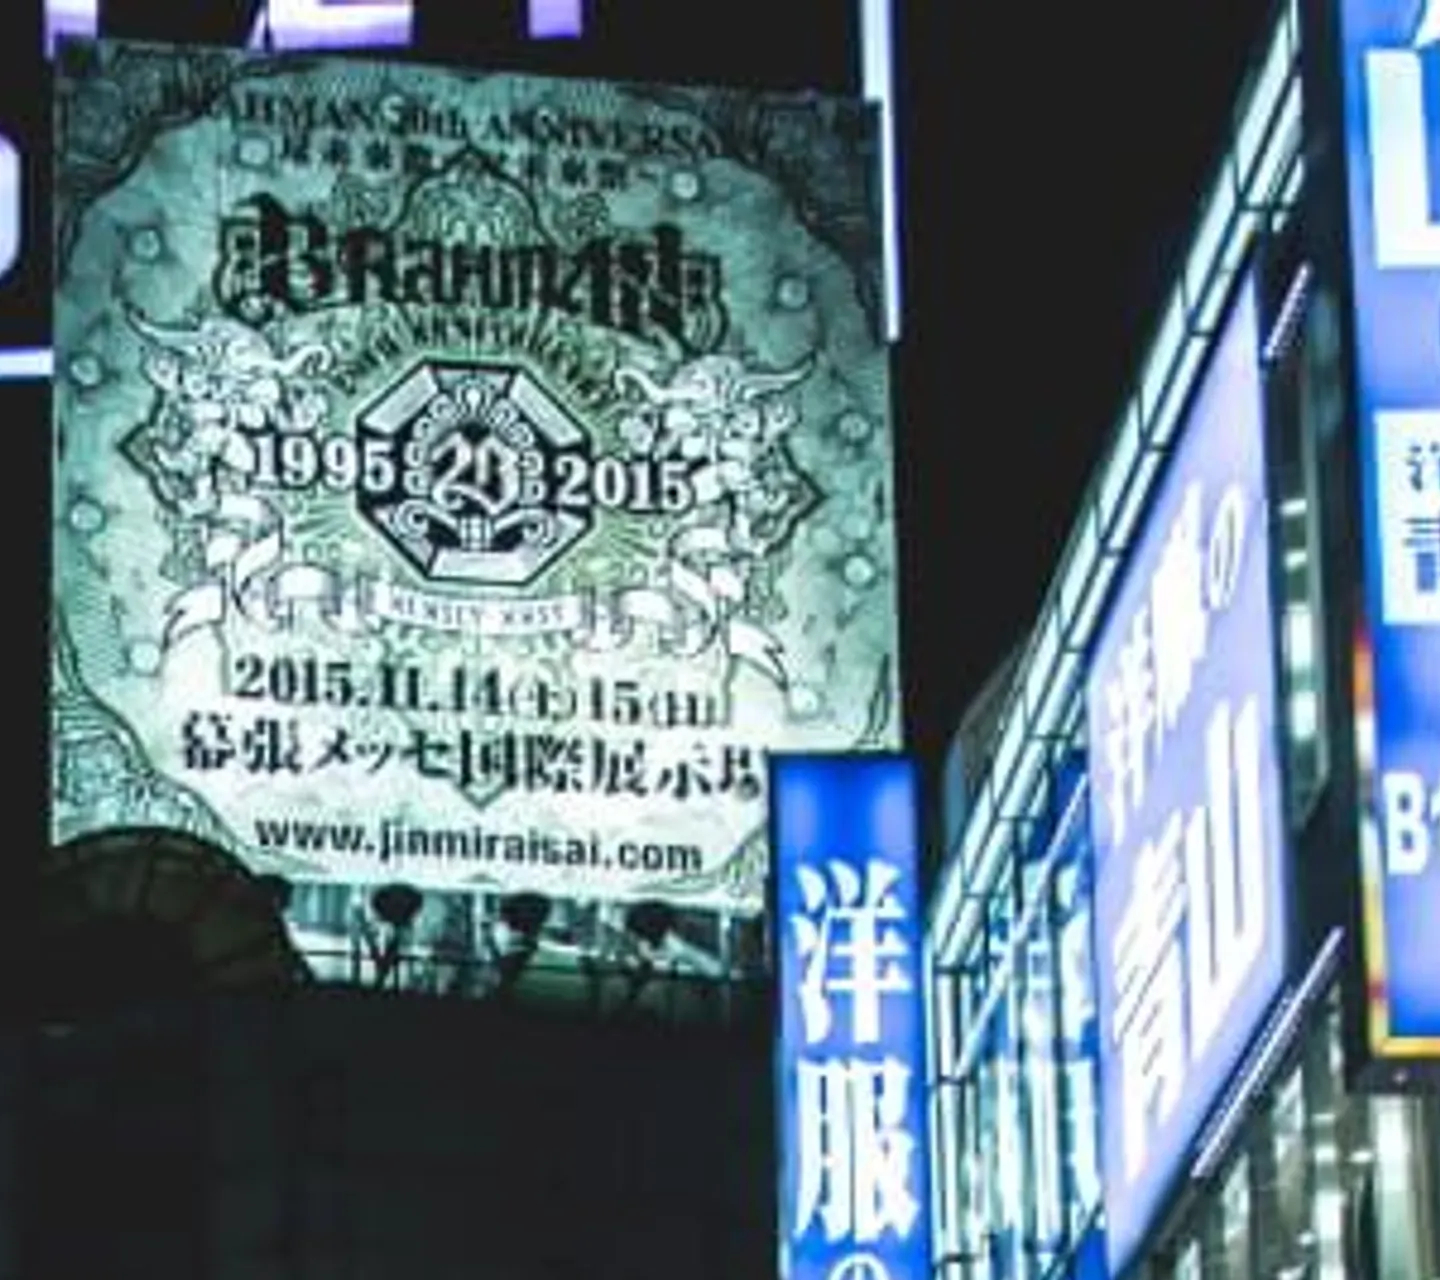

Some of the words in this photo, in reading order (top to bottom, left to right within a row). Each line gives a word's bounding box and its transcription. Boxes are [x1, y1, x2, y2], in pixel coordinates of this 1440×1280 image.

[252, 431, 396, 492] 1995
[553, 453, 693, 513] 2015
[254, 816, 704, 873] www.jinmiraisai.com
